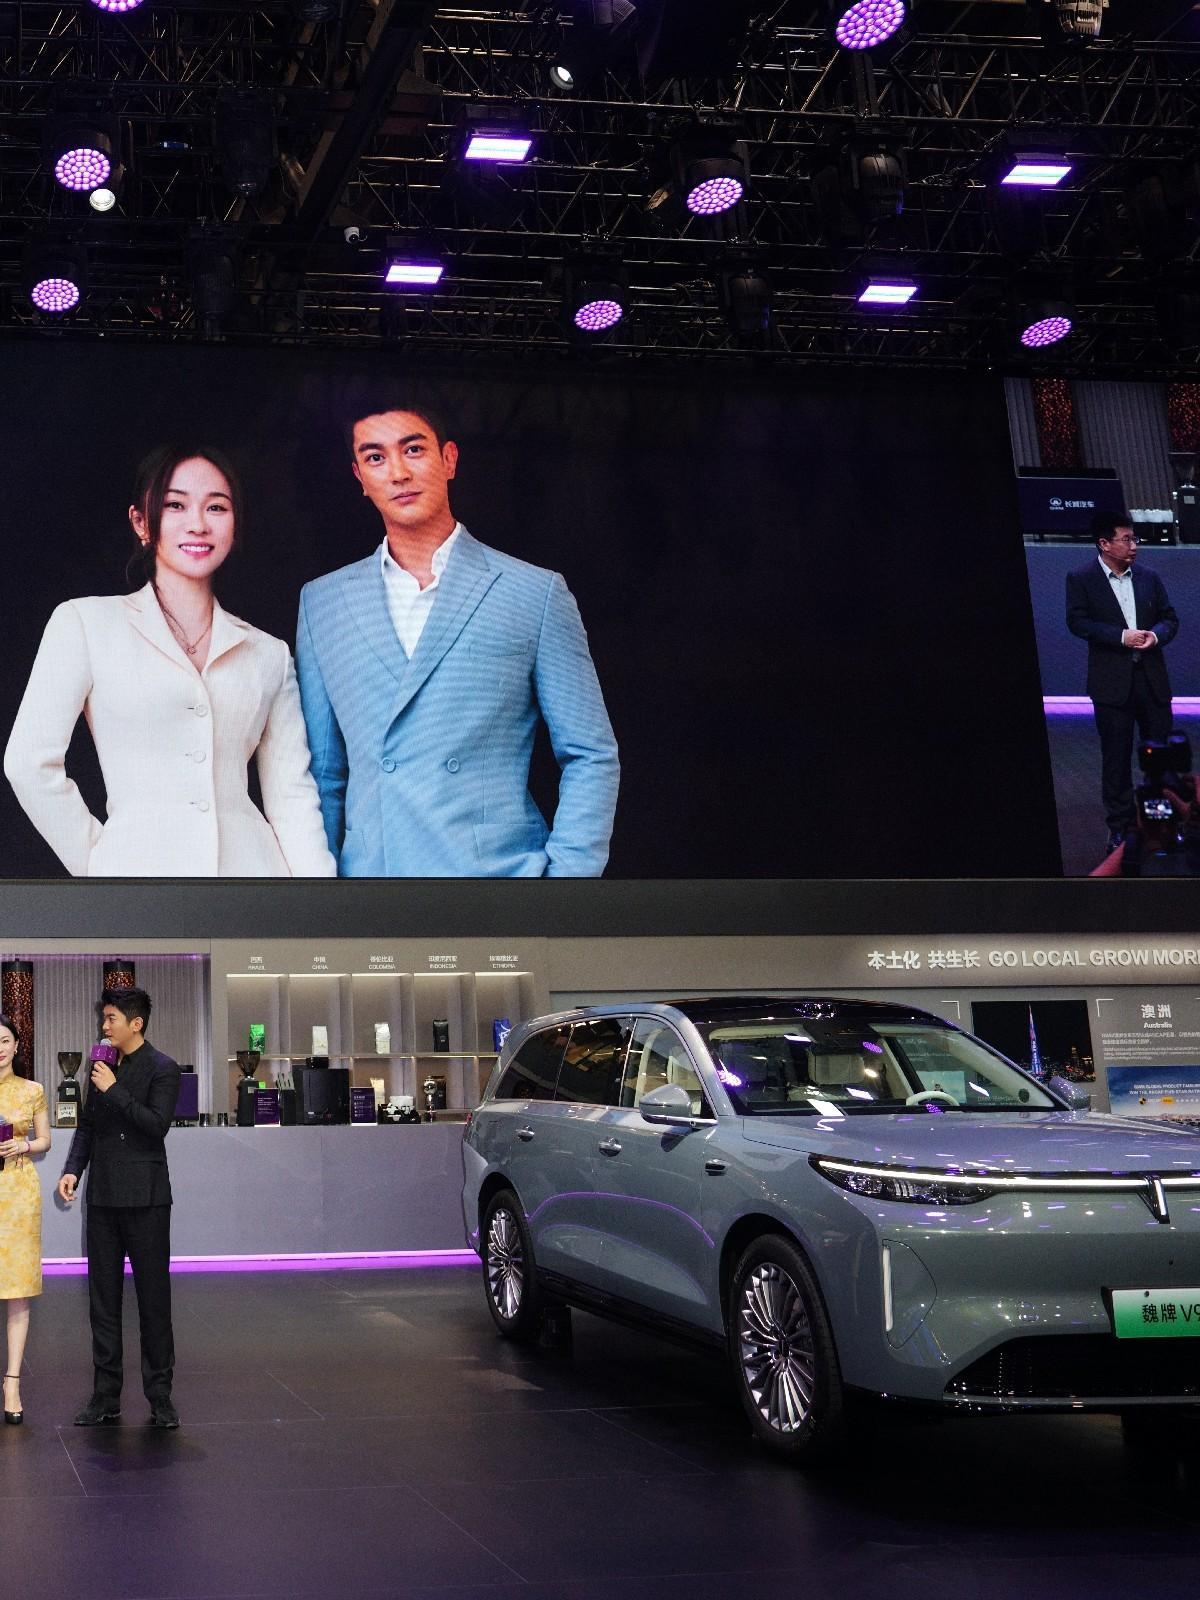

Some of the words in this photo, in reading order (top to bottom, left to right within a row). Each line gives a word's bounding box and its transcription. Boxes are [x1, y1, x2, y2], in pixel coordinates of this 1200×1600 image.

[867, 950, 921, 970] 本土化
[927, 950, 981, 969] 共生长
[988, 950, 1019, 967] GO
[1021, 949, 1086, 967] LOCAL
[1089, 949, 1149, 966] GROW
[1152, 949, 1200, 966] MOR
[1141, 1004, 1172, 1019] 澳洲
[1143, 1021, 1173, 1029] Australia
[1142, 1304, 1177, 1323] 魏牌
